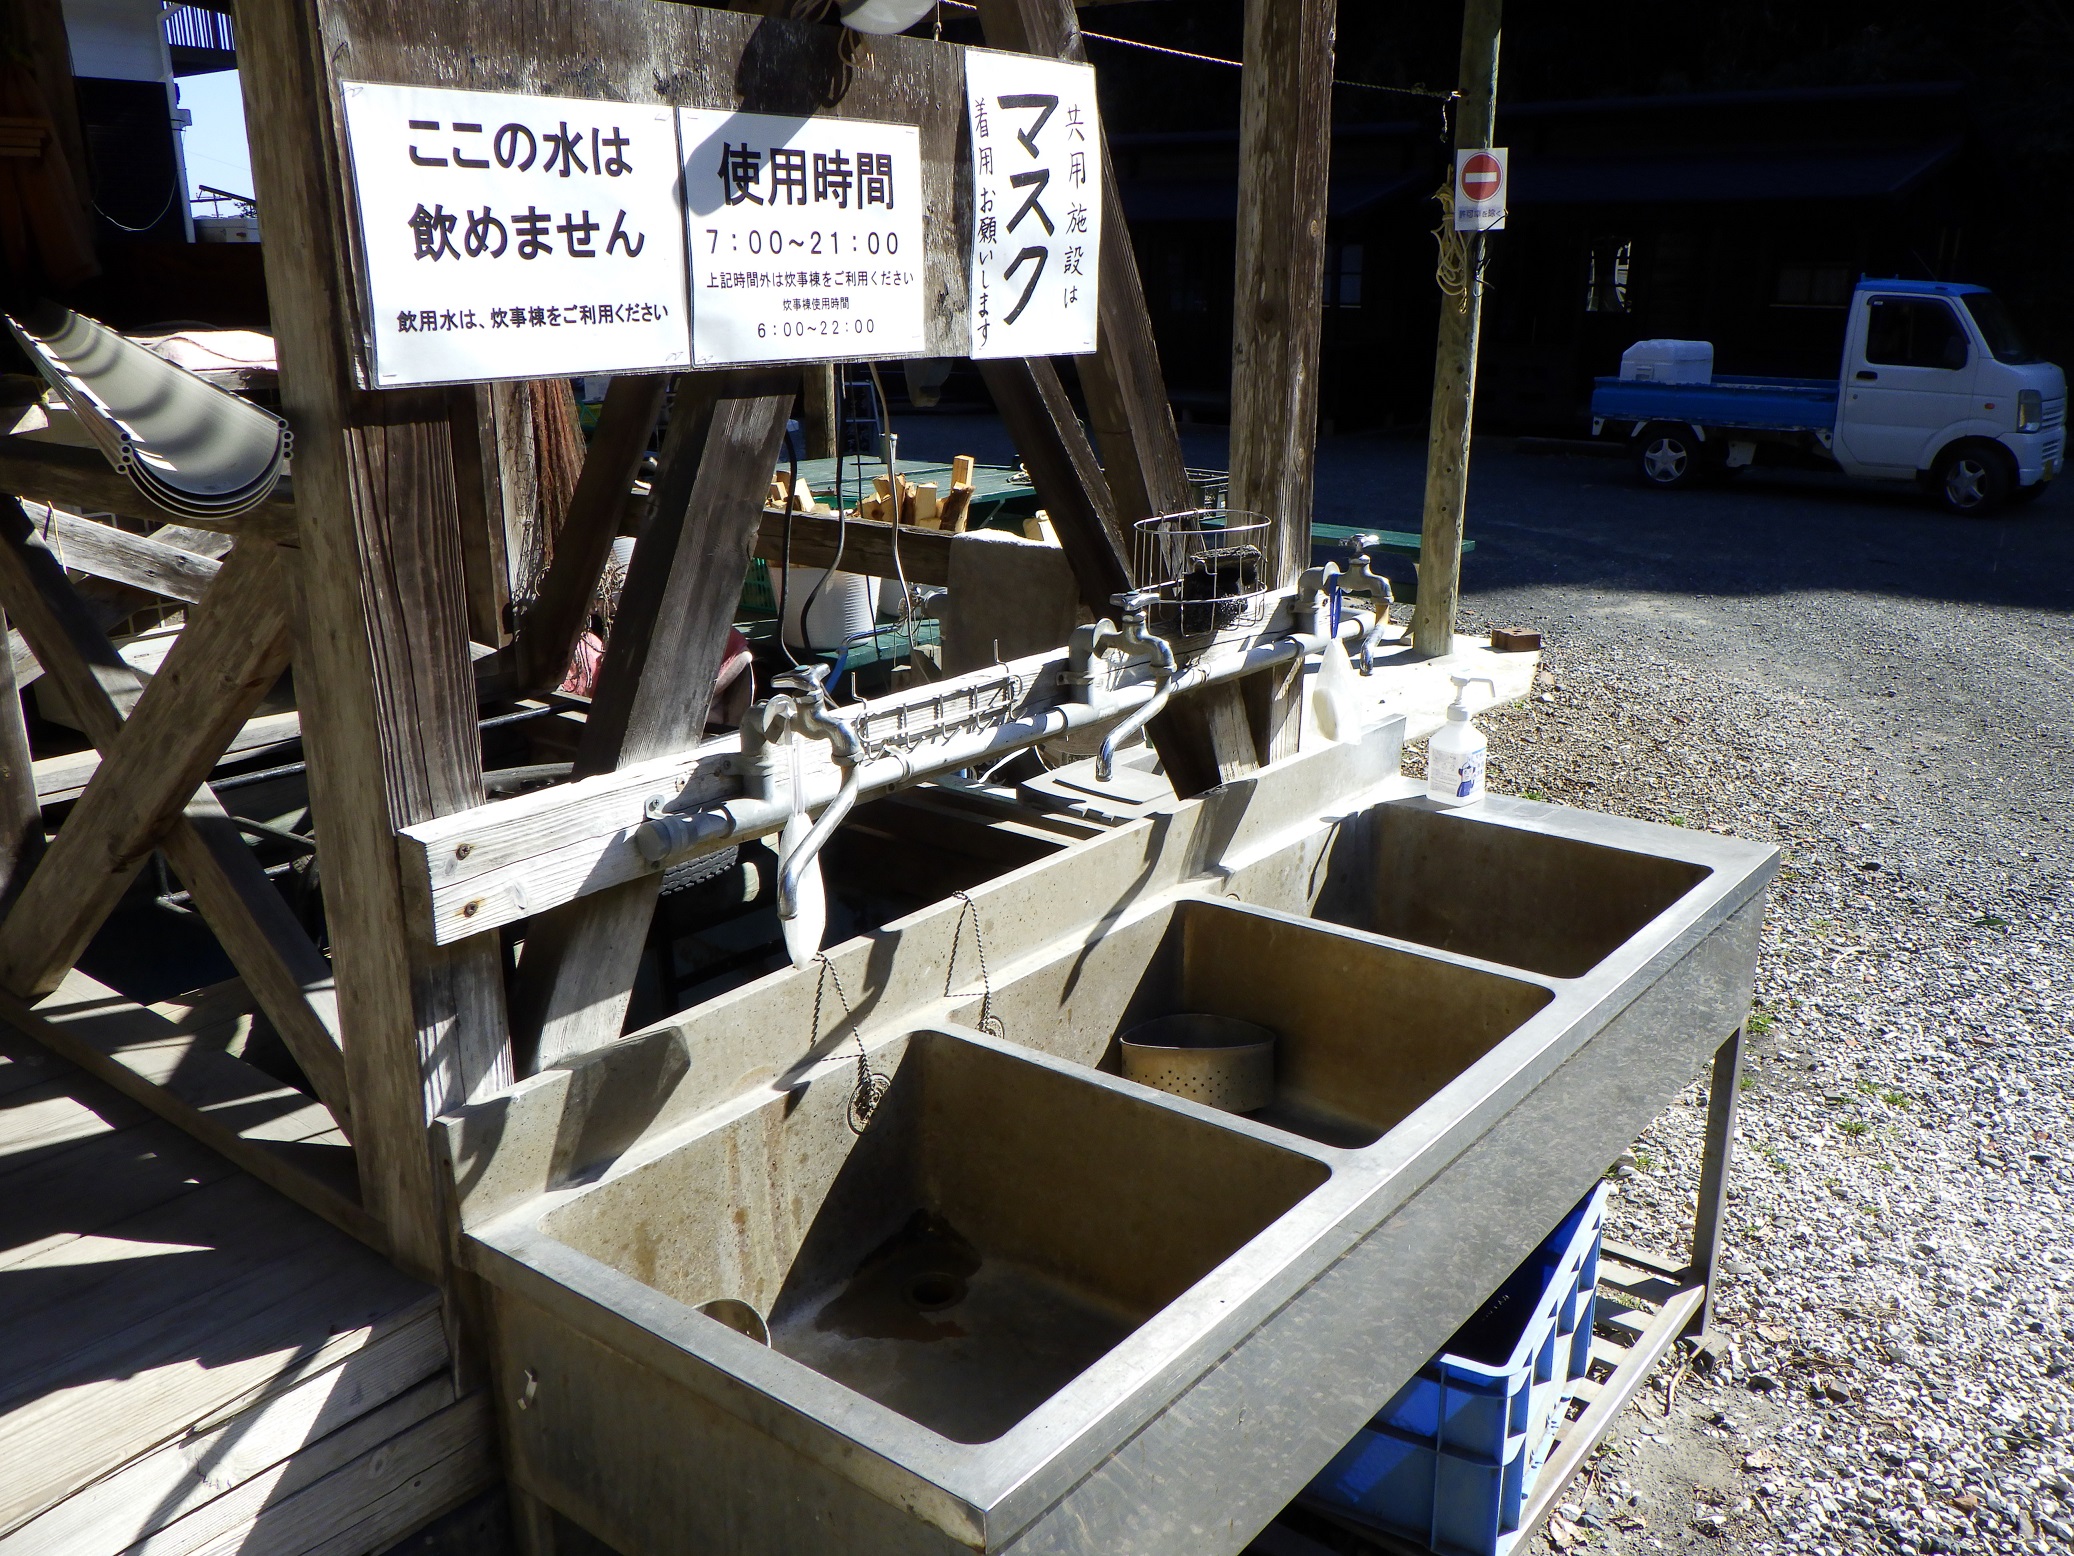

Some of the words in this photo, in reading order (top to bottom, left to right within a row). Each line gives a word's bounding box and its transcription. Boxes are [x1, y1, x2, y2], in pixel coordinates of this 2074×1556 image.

[408, 119, 633, 178] ここの水は
[716, 141, 894, 210] 使用時間
[407, 202, 645, 263] 飲めません
[974, 97, 997, 347] 着用お願いします
[996, 92, 1060, 327] マスク
[1063, 104, 1088, 309] 共用施設は
[706, 270, 914, 289] 上記時間外は炊事棟をご利用ください
[782, 296, 850, 312] 炊事棟使用時間
[396, 302, 669, 333] 飲用水は、炊事棟をご利用ください
